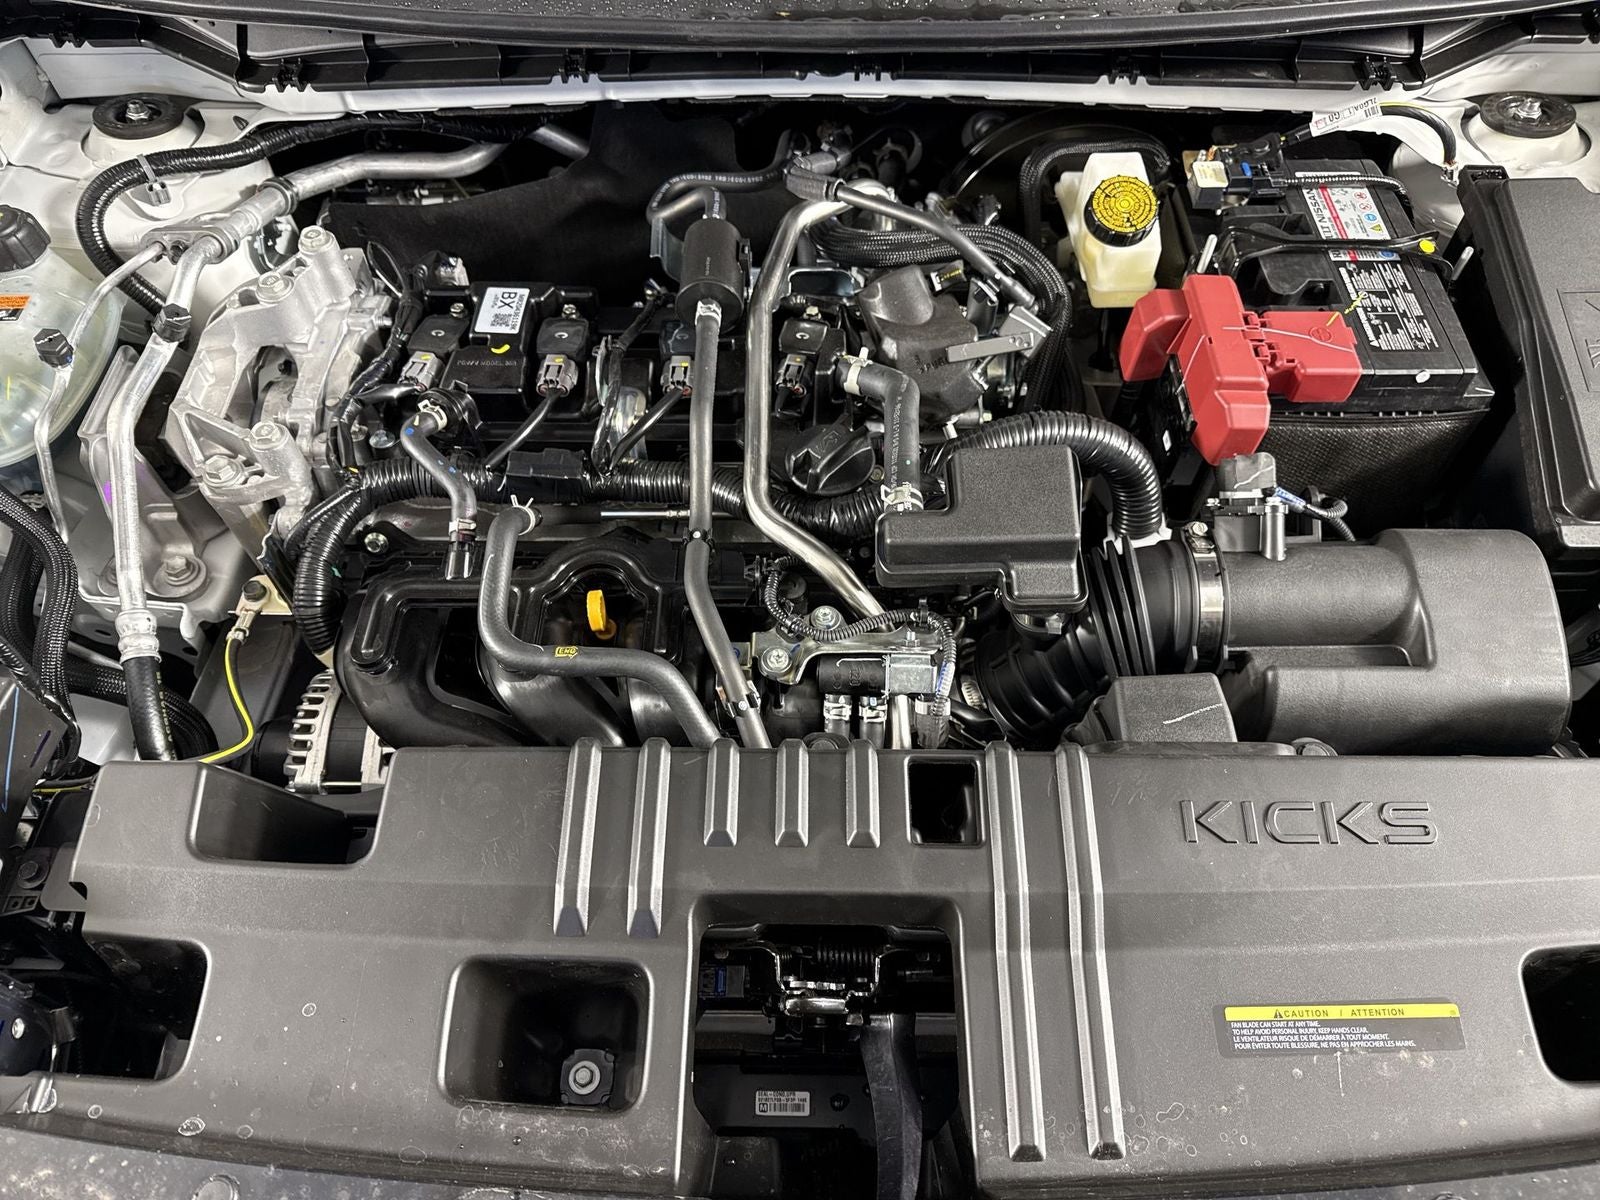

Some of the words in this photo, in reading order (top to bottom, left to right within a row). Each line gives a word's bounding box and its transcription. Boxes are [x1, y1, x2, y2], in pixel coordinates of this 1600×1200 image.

[1306, 189, 1328, 224] NISSAN
[498, 291, 518, 309] BX
[1180, 800, 1438, 845] KICKS
[1284, 1009, 1329, 1018] CAUTION
[1351, 1008, 1405, 1017] ATTENTION
[1288, 1020, 1294, 1028] AT
[1295, 1020, 1306, 1028] ANY
[1309, 1033, 1340, 1041] DÉMARRER
[1252, 1042, 1271, 1050] ÉVITER
[1396, 1039, 1416, 1047] MAINS.
[759, 1103, 768, 1112] M
